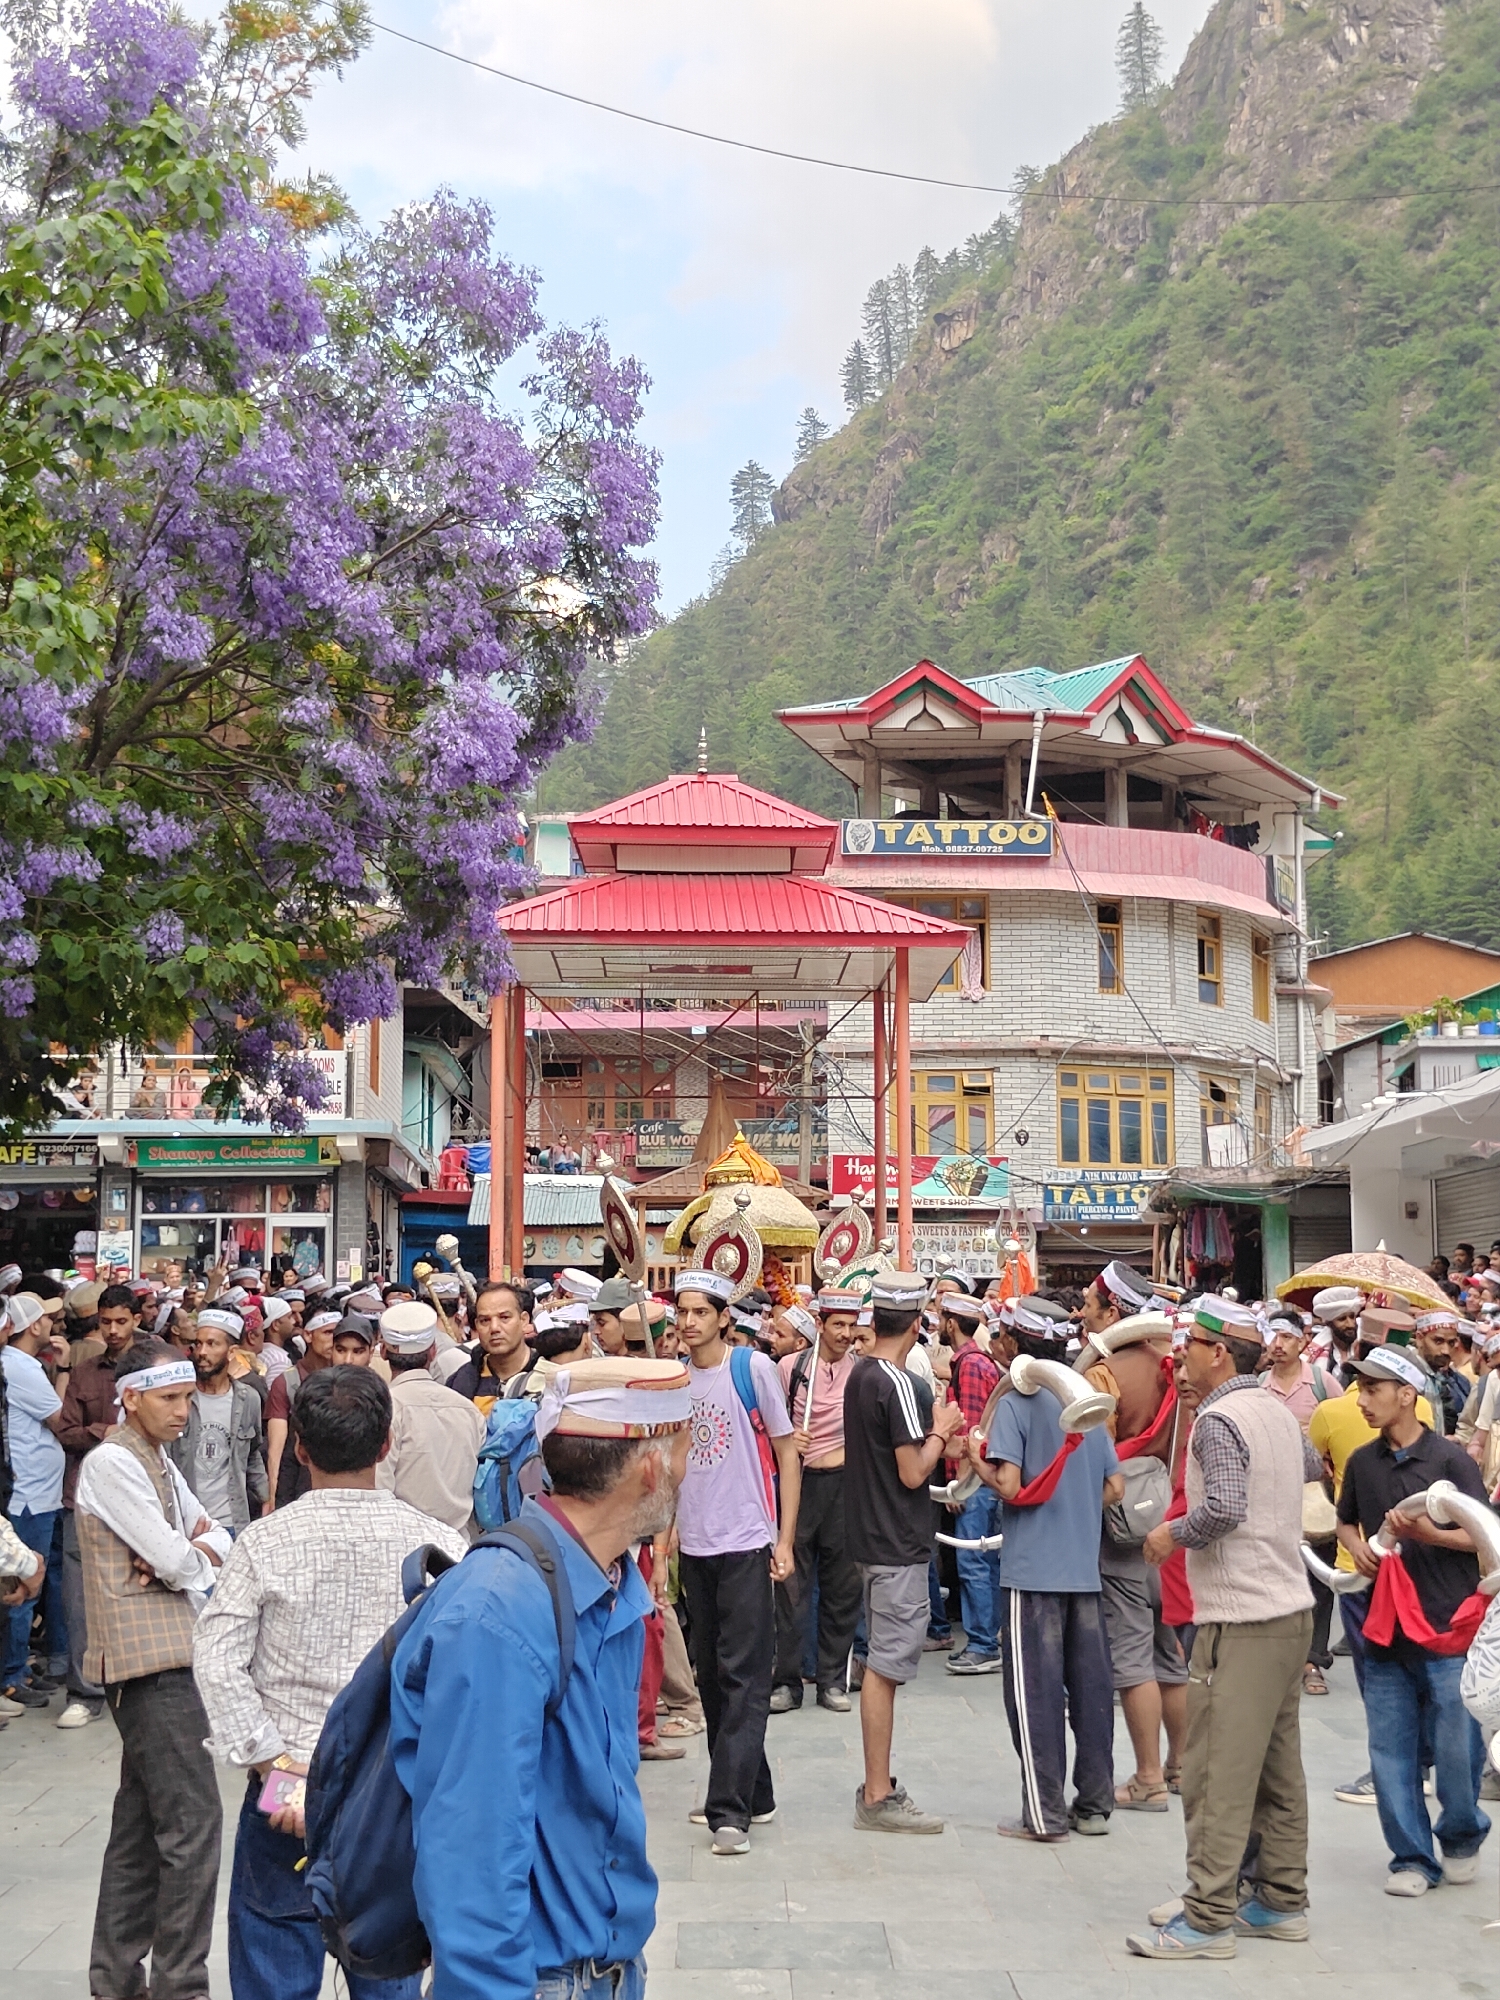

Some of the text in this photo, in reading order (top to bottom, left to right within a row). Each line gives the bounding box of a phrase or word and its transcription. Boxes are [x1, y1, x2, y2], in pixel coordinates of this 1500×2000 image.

[877, 823, 1047, 845] TATTOO
[640, 1121, 664, 1134] Cafe
[769, 1119, 799, 1134] Cafe
[639, 1135, 698, 1146] BLUE WOR
[776, 1133, 828, 1147] WOLD
[149, 1145, 306, 1163] Shanaya Collections
[1101, 1171, 1117, 1181] INK
[1117, 1171, 1139, 1181] ZONE
[1048, 1184, 1151, 1205] TATTO
[949, 1198, 974, 1207] SHOP
[1078, 1205, 1108, 1213] PIERCING
[917, 1225, 950, 1236] SWEETS
[951, 1225, 957, 1236] &
[958, 1225, 978, 1236] FAST
